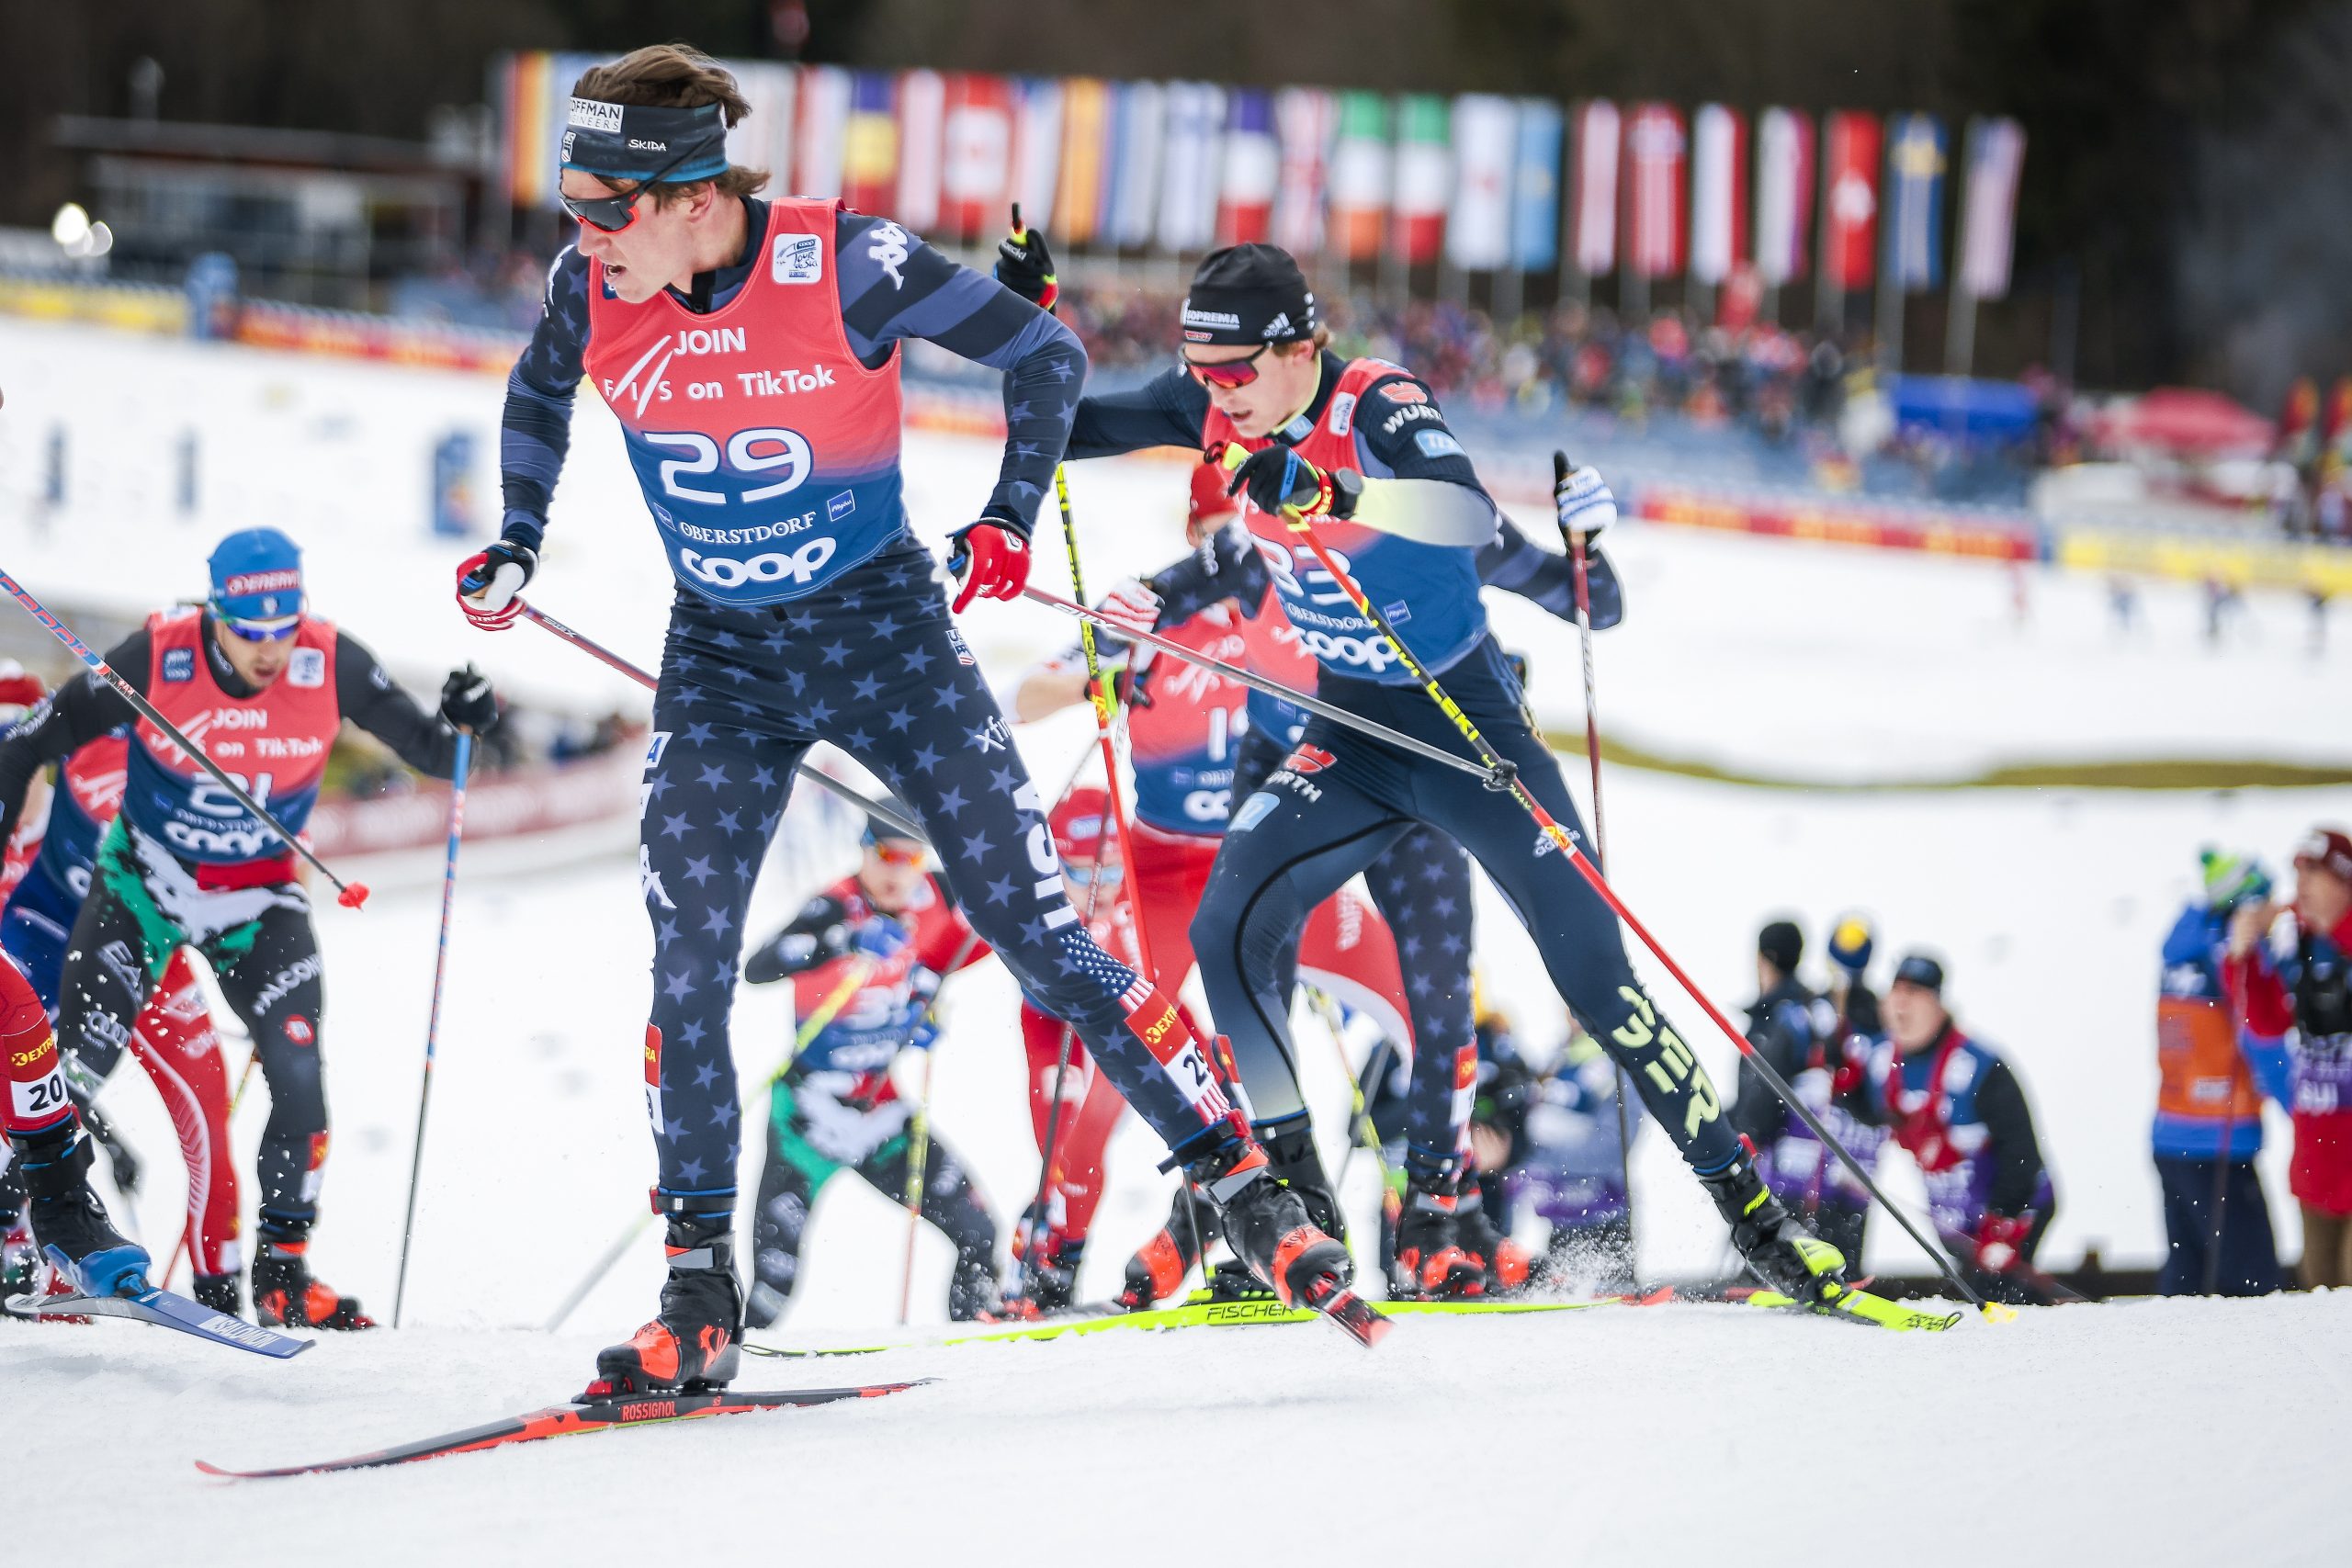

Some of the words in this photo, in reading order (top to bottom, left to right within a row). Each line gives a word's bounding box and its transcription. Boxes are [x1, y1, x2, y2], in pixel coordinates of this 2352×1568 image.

[570, 99, 621, 119] OFFMAN
[628, 139, 667, 152] SKIDA
[673, 327, 746, 356] JOIN
[689, 380, 724, 400] on
[738, 364, 837, 397] TikTok
[644, 427, 814, 505] 29
[678, 511, 818, 545] OBERSTDORF
[682, 536, 837, 588] coop
[211, 708, 268, 730] JOIN
[215, 740, 245, 758] on
[28, 1073, 62, 1111] 20
[622, 1401, 677, 1421] ROSSIGNOL
